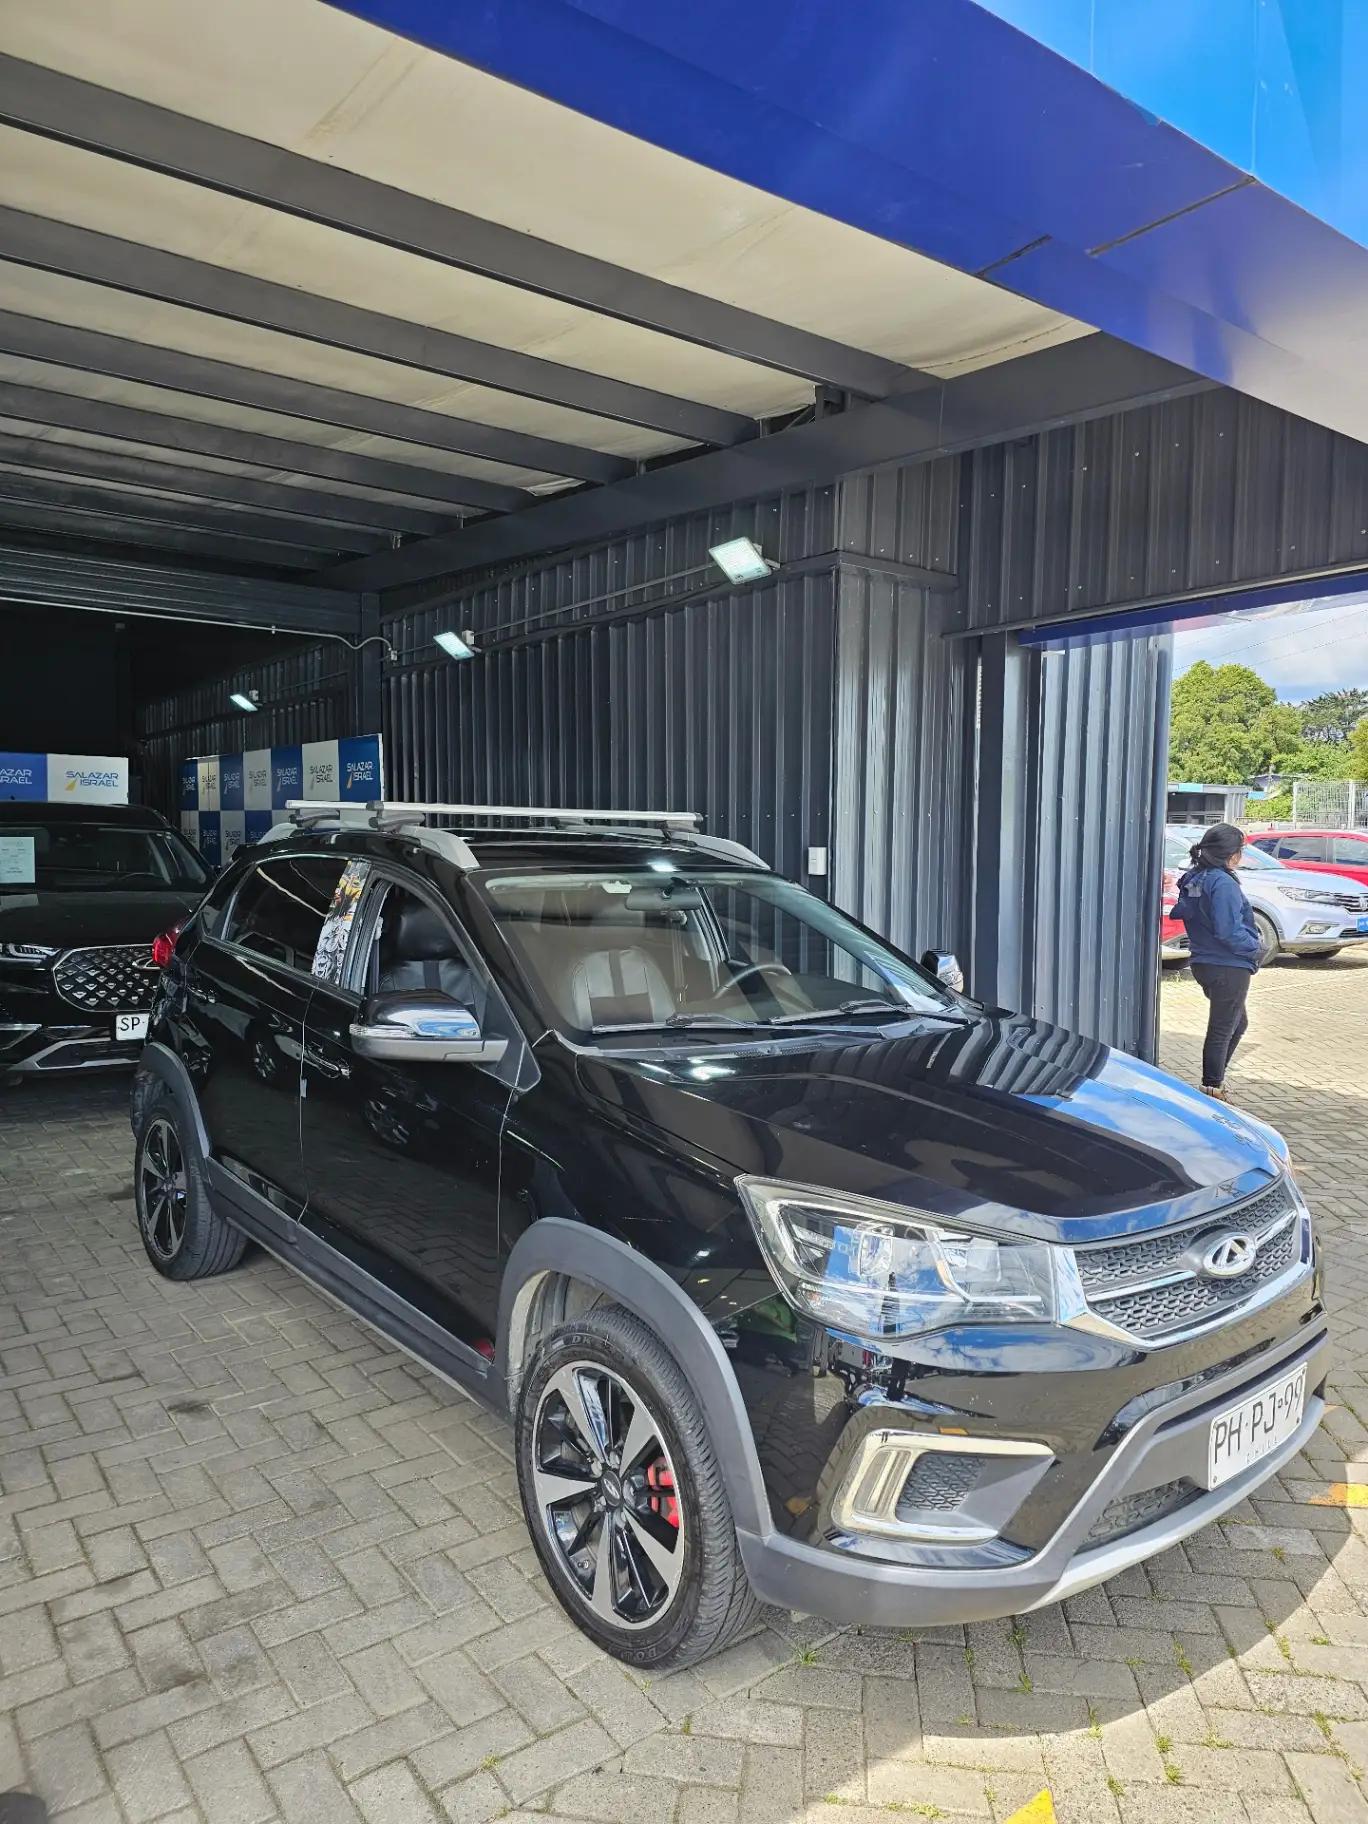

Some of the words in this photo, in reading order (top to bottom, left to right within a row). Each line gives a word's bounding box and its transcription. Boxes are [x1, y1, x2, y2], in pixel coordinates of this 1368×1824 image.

[346, 761, 373, 772] SALAZAR
[66, 770, 119, 780] SALAZAR
[353, 771, 374, 781] ISRAEL
[0, 776, 32, 785] RAEL
[80, 779, 119, 788] ISRAEL
